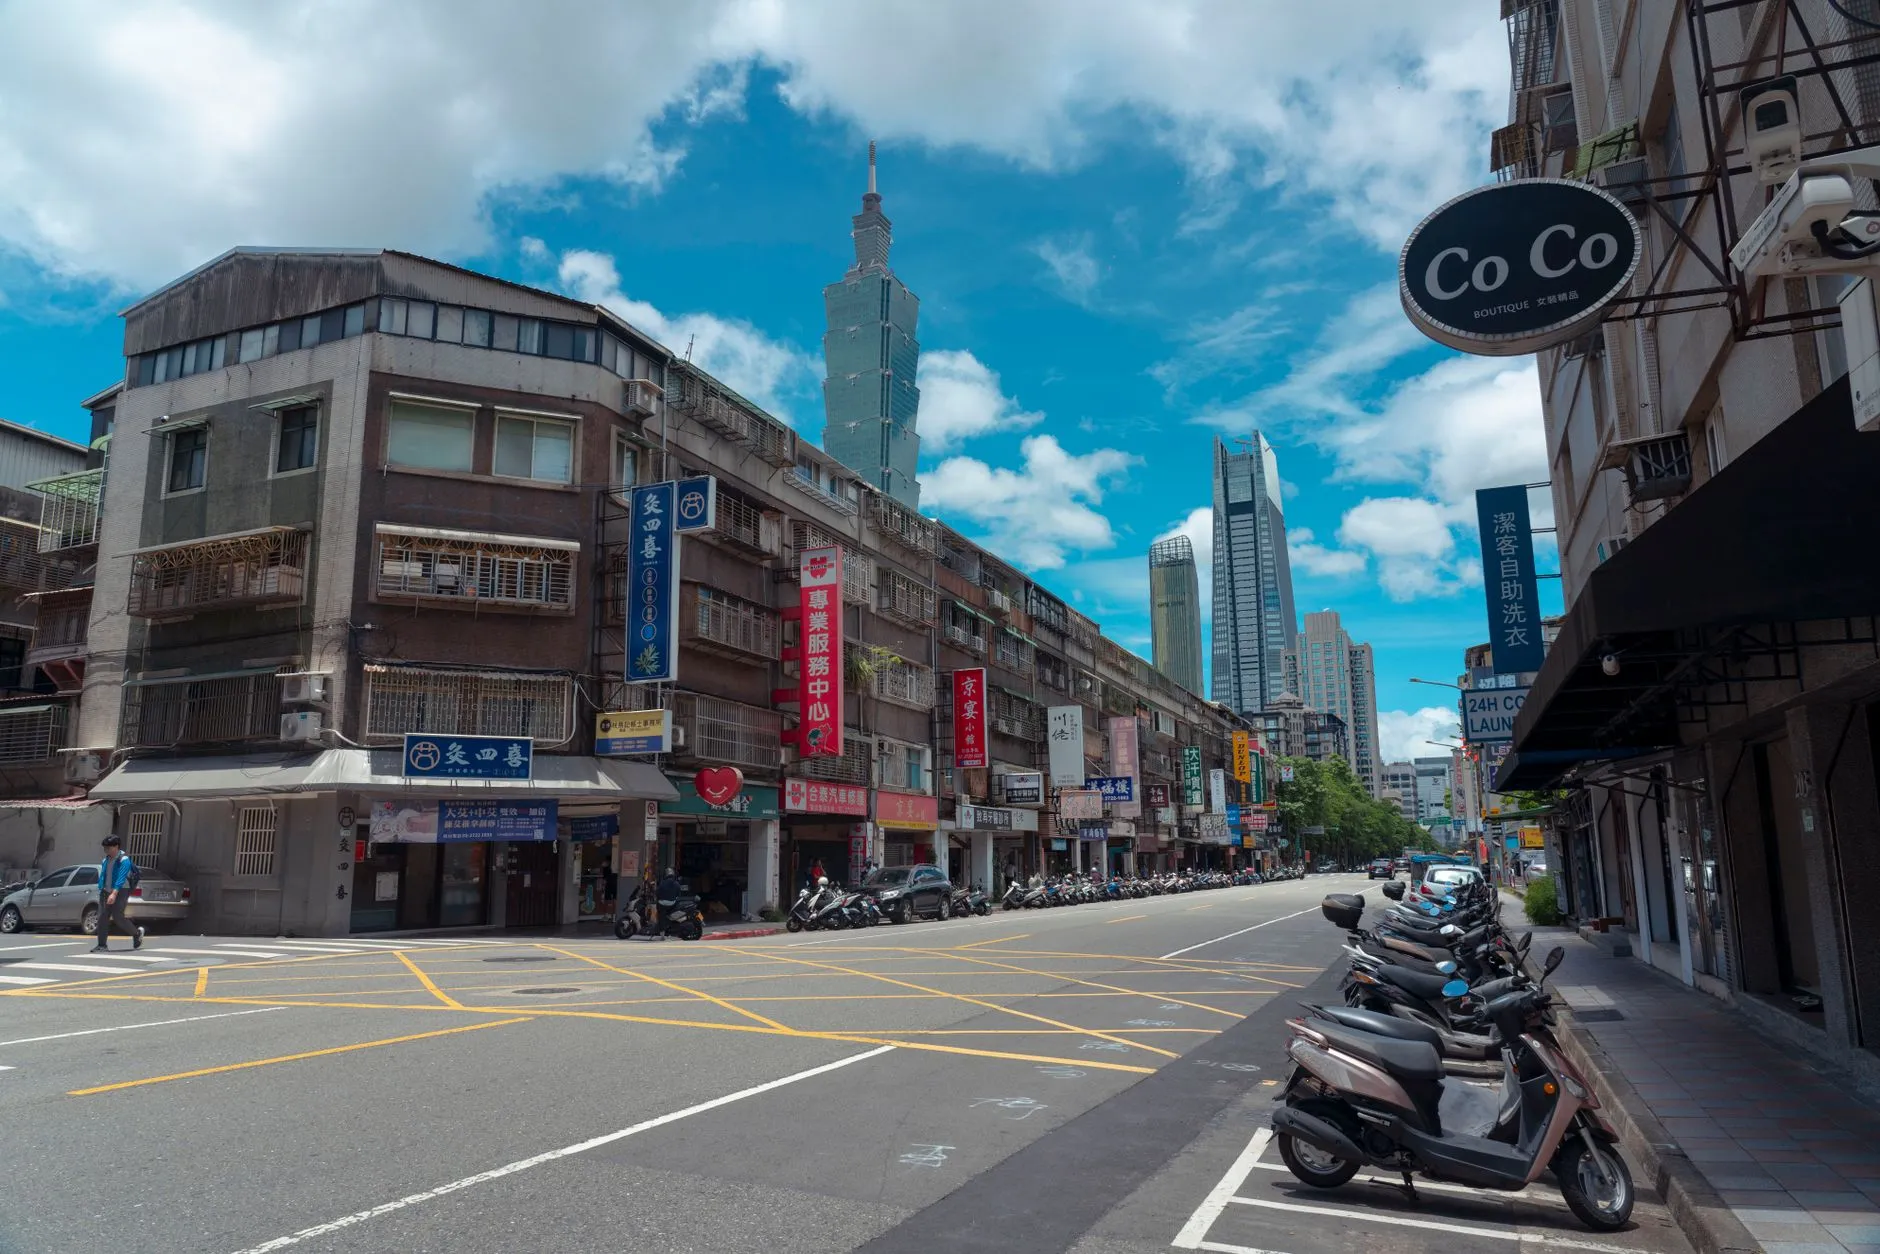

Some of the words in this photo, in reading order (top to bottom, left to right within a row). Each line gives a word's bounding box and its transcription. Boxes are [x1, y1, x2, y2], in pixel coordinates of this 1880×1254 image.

[1424, 246, 1510, 301] Co
[1529, 223, 1619, 279] Co
[1473, 300, 1530, 320] BOUTIQUE
[1536, 290, 1580, 308] 女裝精品
[640, 492, 664, 559] 灸四喜
[1493, 511, 1530, 648] 潔客自助洗衣
[807, 589, 830, 722] 專業服務中心
[1468, 697, 1498, 713] 24H
[444, 741, 529, 768] 灸四喜
[1237, 743, 1246, 777] DUNLOP
